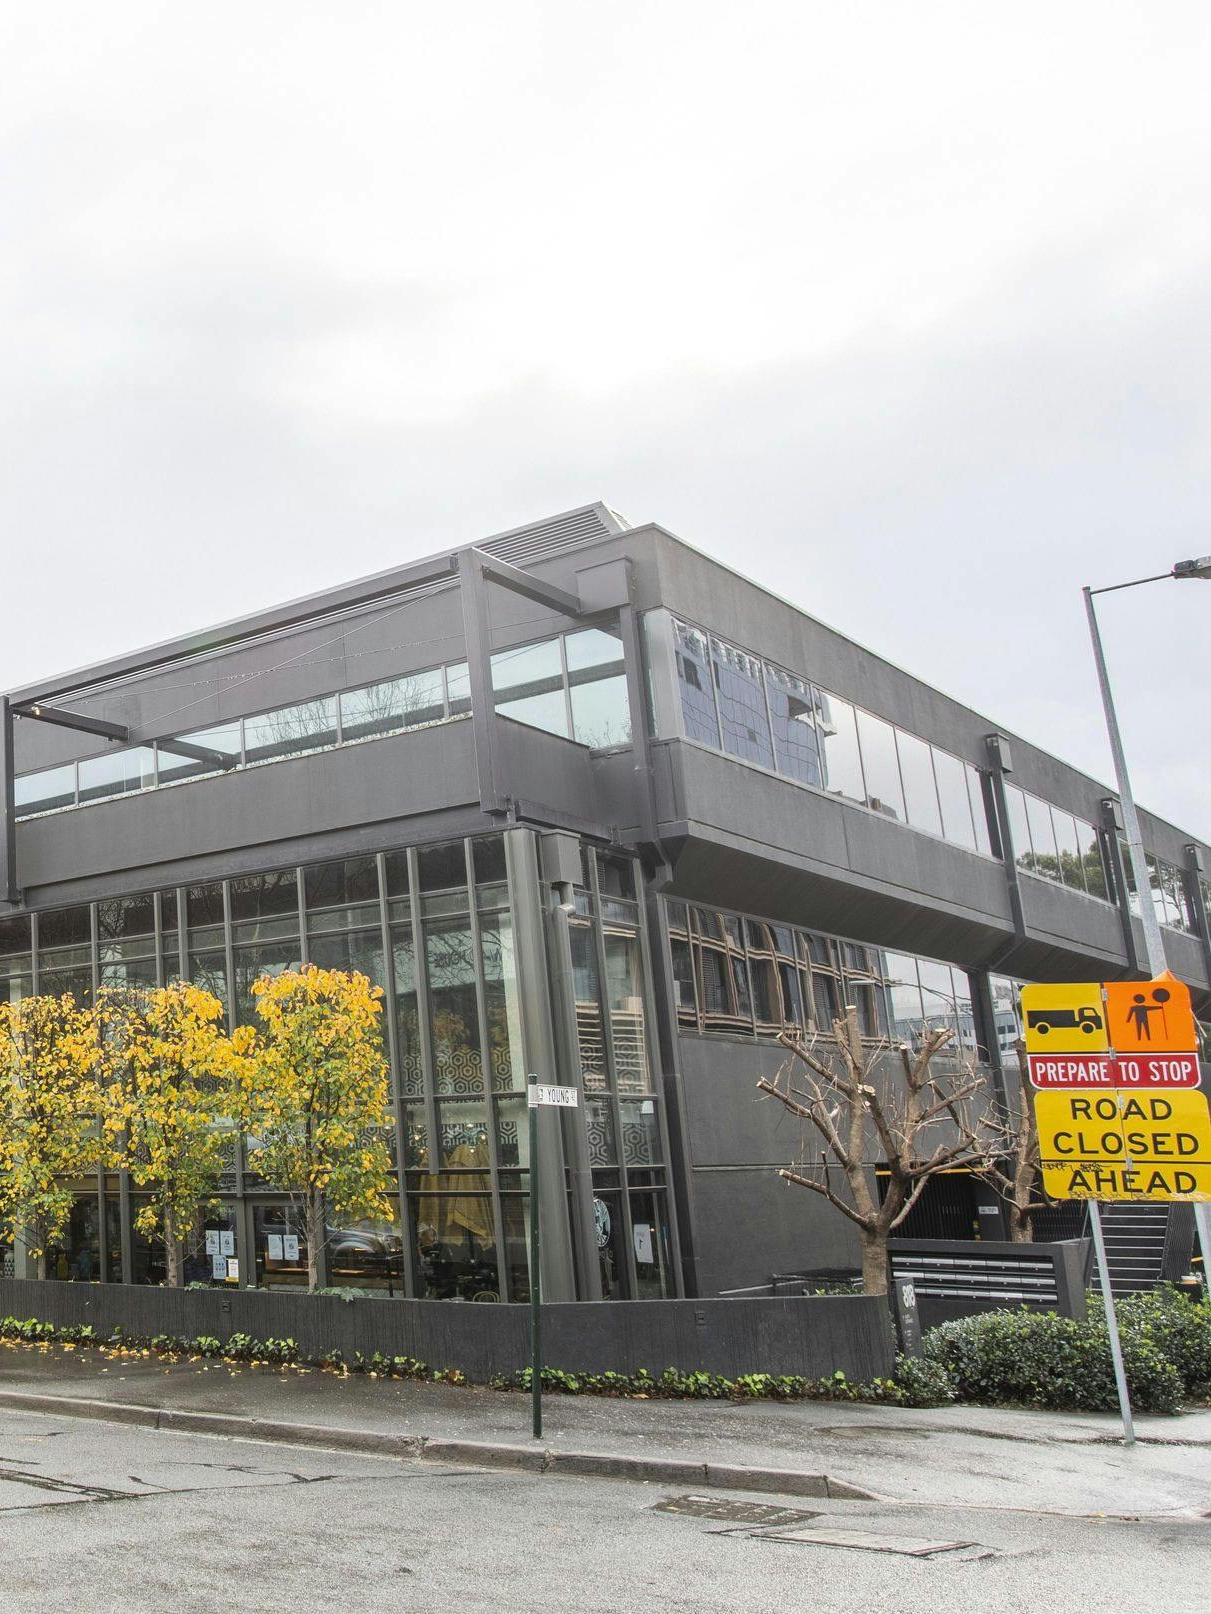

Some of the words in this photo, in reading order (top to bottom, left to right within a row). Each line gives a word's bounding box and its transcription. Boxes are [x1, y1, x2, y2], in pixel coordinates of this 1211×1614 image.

[1036, 1062, 1110, 1082] PREPARE
[1118, 1062, 1140, 1082] TO
[1150, 1061, 1192, 1081] STOP
[547, 1088, 569, 1103] YOUNG
[1070, 1098, 1172, 1120] ROAD
[1053, 1132, 1199, 1156] CLOSED
[1068, 1170, 1197, 1194] AHEAD
